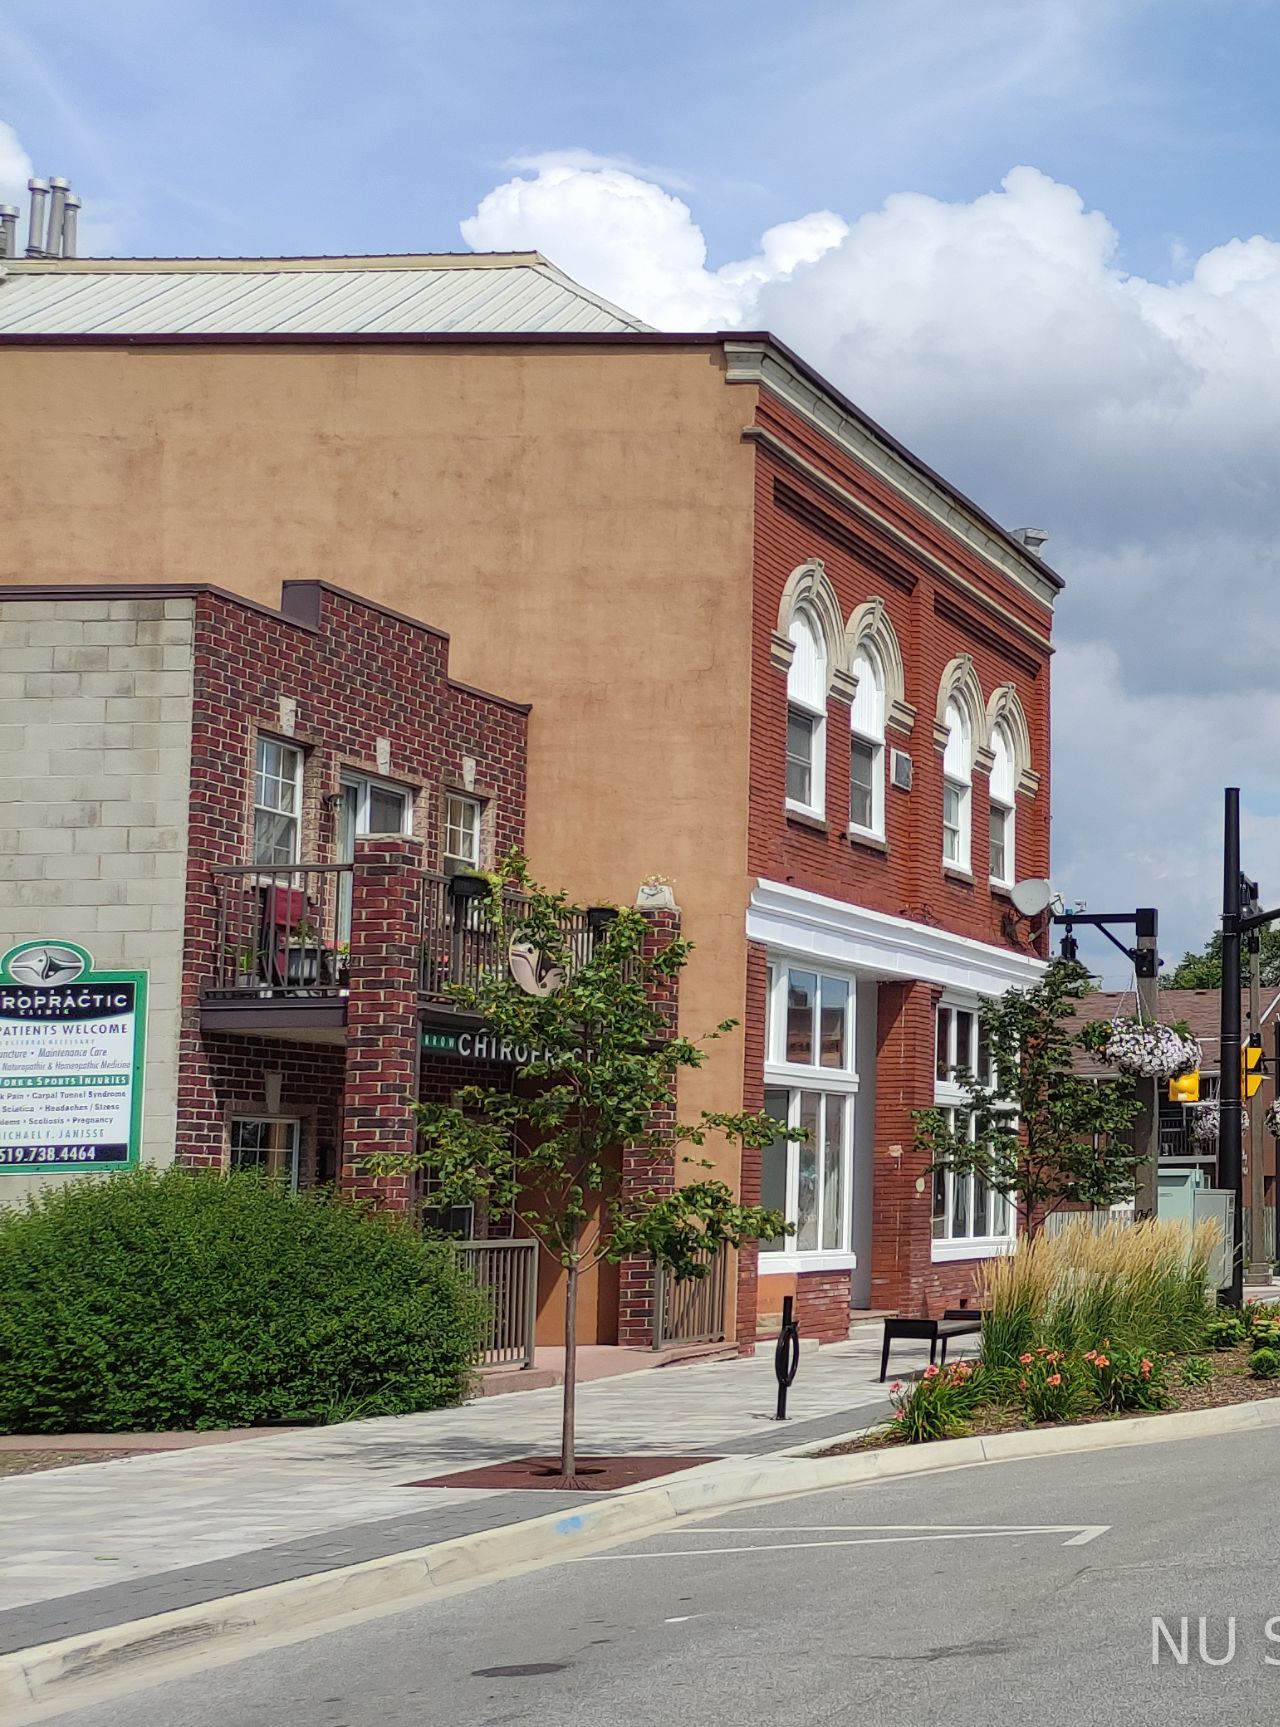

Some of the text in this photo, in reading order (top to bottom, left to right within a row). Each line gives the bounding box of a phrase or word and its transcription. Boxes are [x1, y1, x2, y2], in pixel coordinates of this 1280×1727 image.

[63, 1023, 128, 1035] WELCOME
[424, 1034, 455, 1048] RROW
[38, 1048, 87, 1058] Maintenance
[90, 1046, 108, 1057] Care
[55, 1061, 98, 1072] Homeopathic
[101, 1060, 131, 1070] Medicine
[0, 1077, 24, 1087] ORK
[36, 1076, 76, 1087] SPORTS
[79, 1075, 127, 1086] INJURIES
[7, 1092, 24, 1100] Pain
[32, 1091, 57, 1100] Carpal
[60, 1091, 86, 1099] Tunnel
[88, 1090, 126, 1099] Syndrome
[45, 1104, 88, 1112] Headaches
[94, 1103, 120, 1111] Stress
[28, 1117, 65, 1125] Scoliosis
[72, 1116, 114, 1125] Pregnancy
[0, 1130, 42, 1140] ICHAEL
[0, 1146, 96, 1163] 519.738.4464
